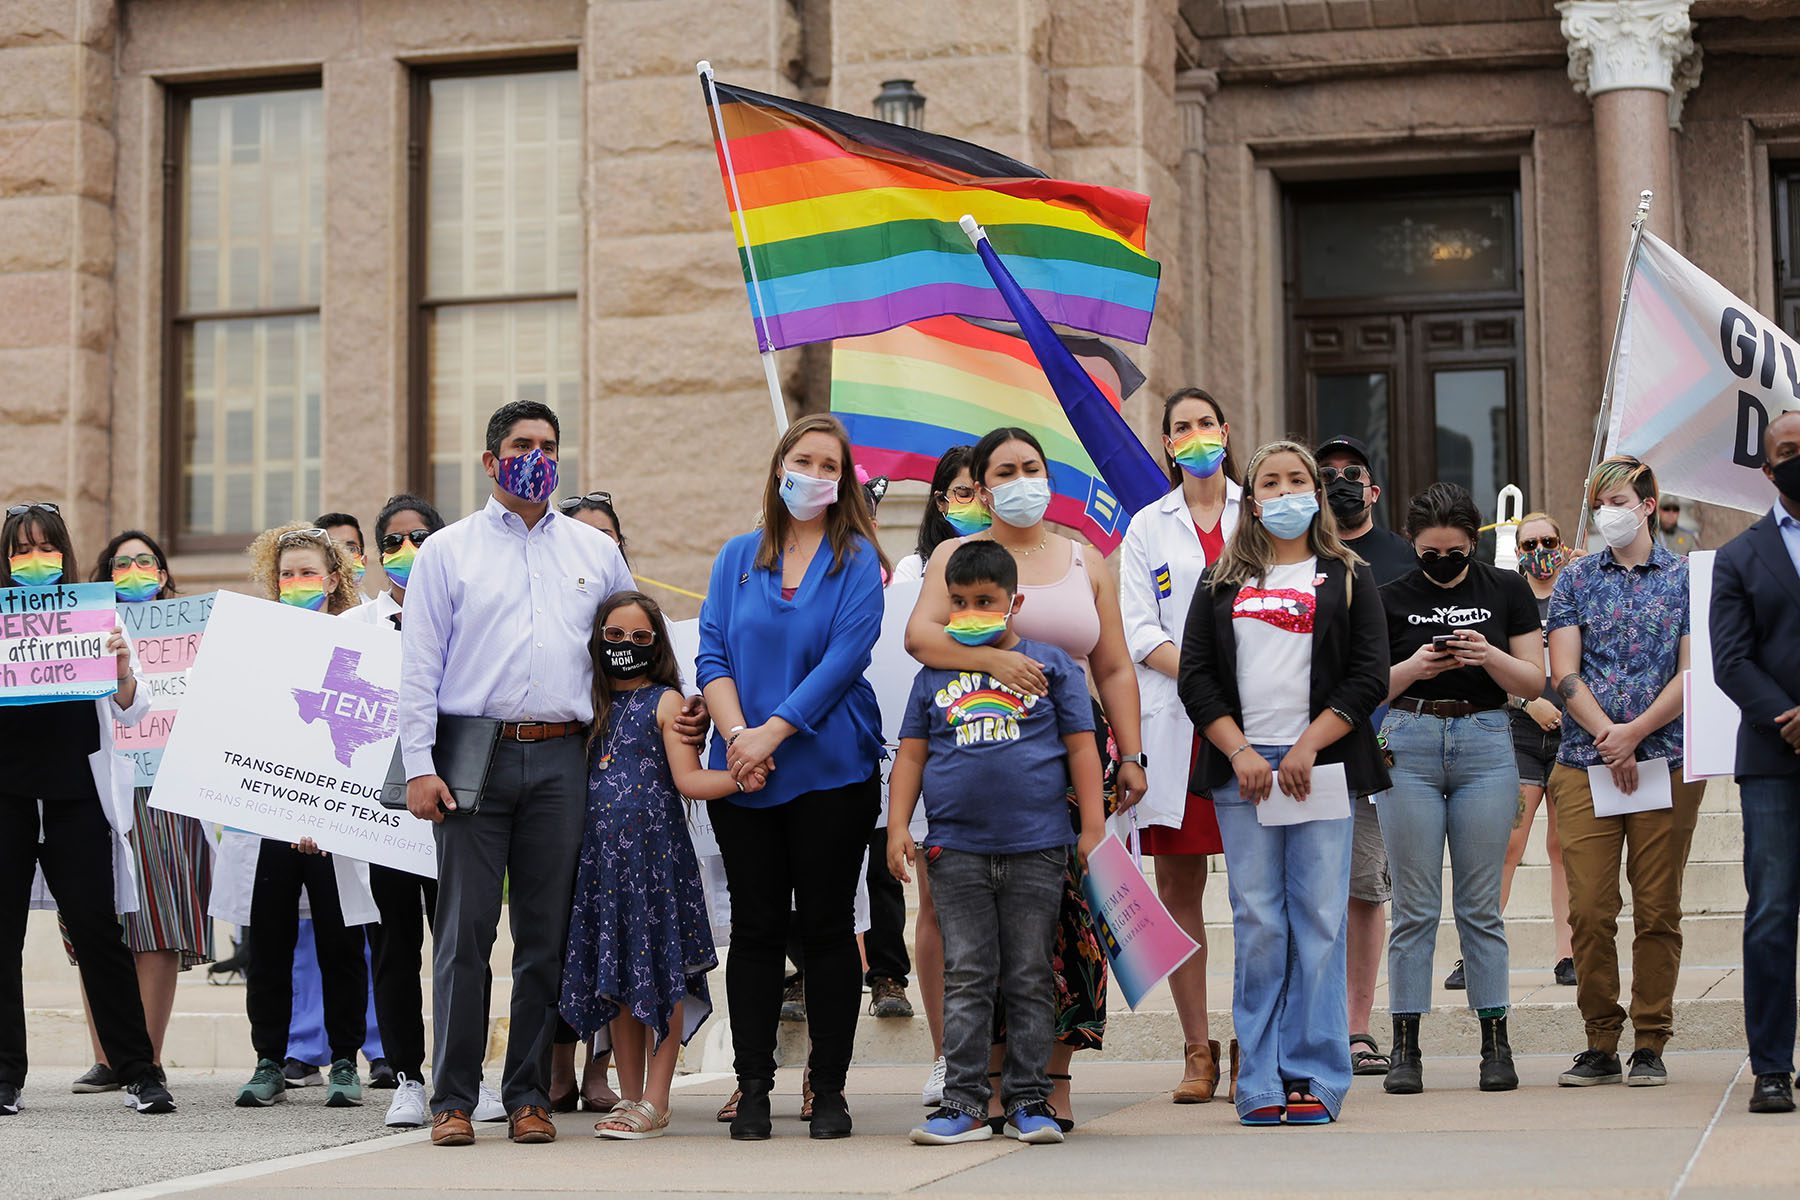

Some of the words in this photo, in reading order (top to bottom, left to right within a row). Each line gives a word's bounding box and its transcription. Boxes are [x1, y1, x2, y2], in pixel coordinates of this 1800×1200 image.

[119, 600, 192, 631] NDER
[9, 636, 101, 662] affirming
[138, 633, 203, 664] POETR
[610, 655, 634, 667] MONI
[30, 663, 77, 685] care
[934, 672, 983, 709] GOOD
[318, 687, 398, 729] TENT
[955, 717, 1021, 747] AHEAD
[124, 752, 155, 777] RE
[223, 751, 338, 790] TRANSGENDER
[240, 777, 320, 808] NETWORK
[324, 798, 348, 814] OF
[350, 806, 401, 828] TEXAS
[198, 788, 241, 808] TRANS
[246, 800, 294, 821] RIGHTS
[297, 814, 325, 829] ARE
[329, 816, 380, 843] HUMAN
[383, 835, 435, 857] RIGHTS
[1102, 881, 1131, 917] HUMAN
[1111, 898, 1142, 933] RIGHTS
